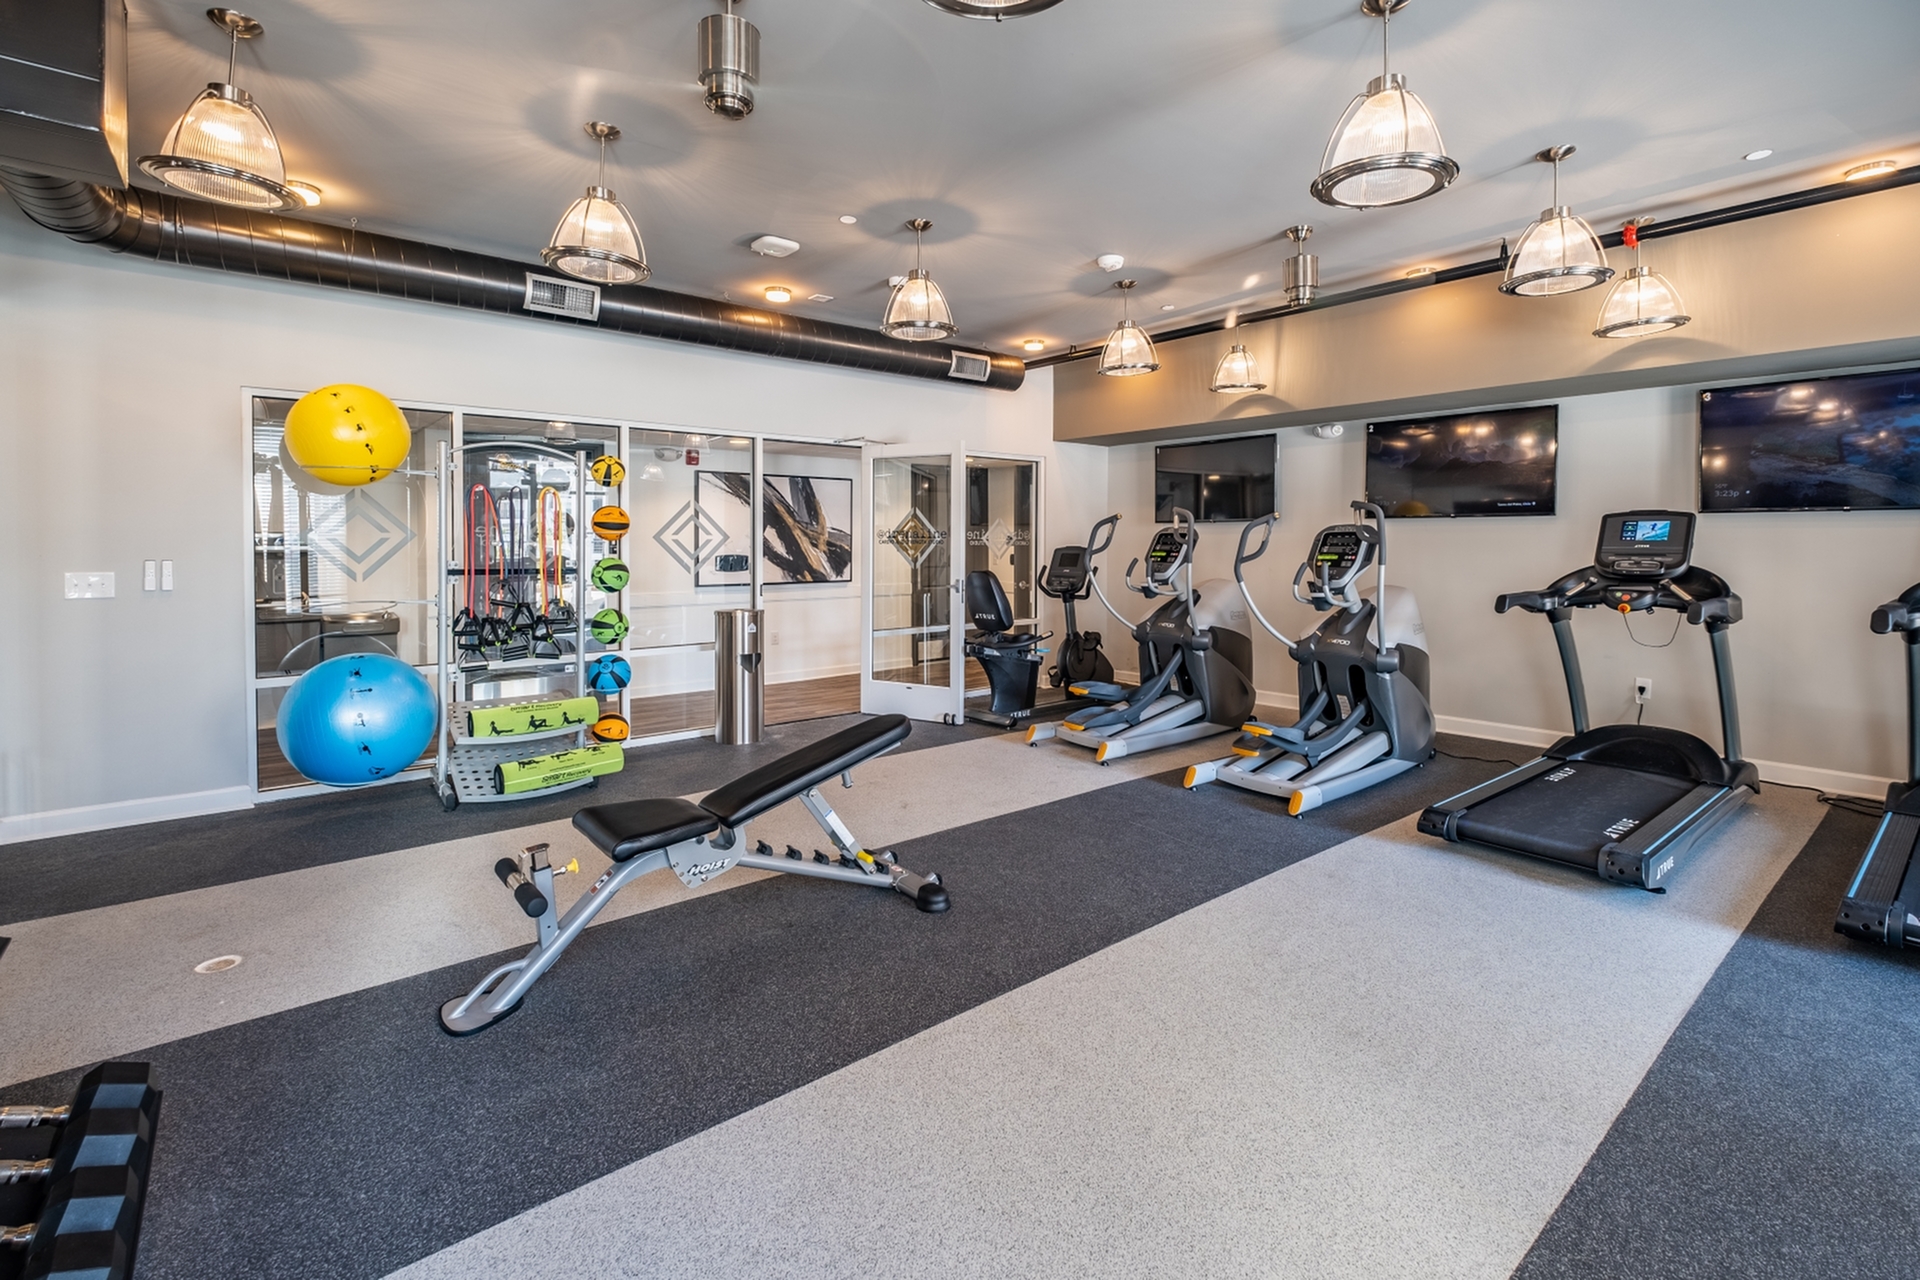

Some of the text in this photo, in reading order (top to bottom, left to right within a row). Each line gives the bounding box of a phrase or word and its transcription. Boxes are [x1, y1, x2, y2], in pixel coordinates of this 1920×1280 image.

[876, 528, 947, 540] @drenaline
[977, 612, 996, 620] TRUE
[1013, 709, 1031, 718] TRUE
[566, 769, 592, 777] Recovery
[1605, 818, 1640, 836] TRUE
[688, 857, 732, 876] HOIST
[1659, 856, 1674, 876] TRUE
